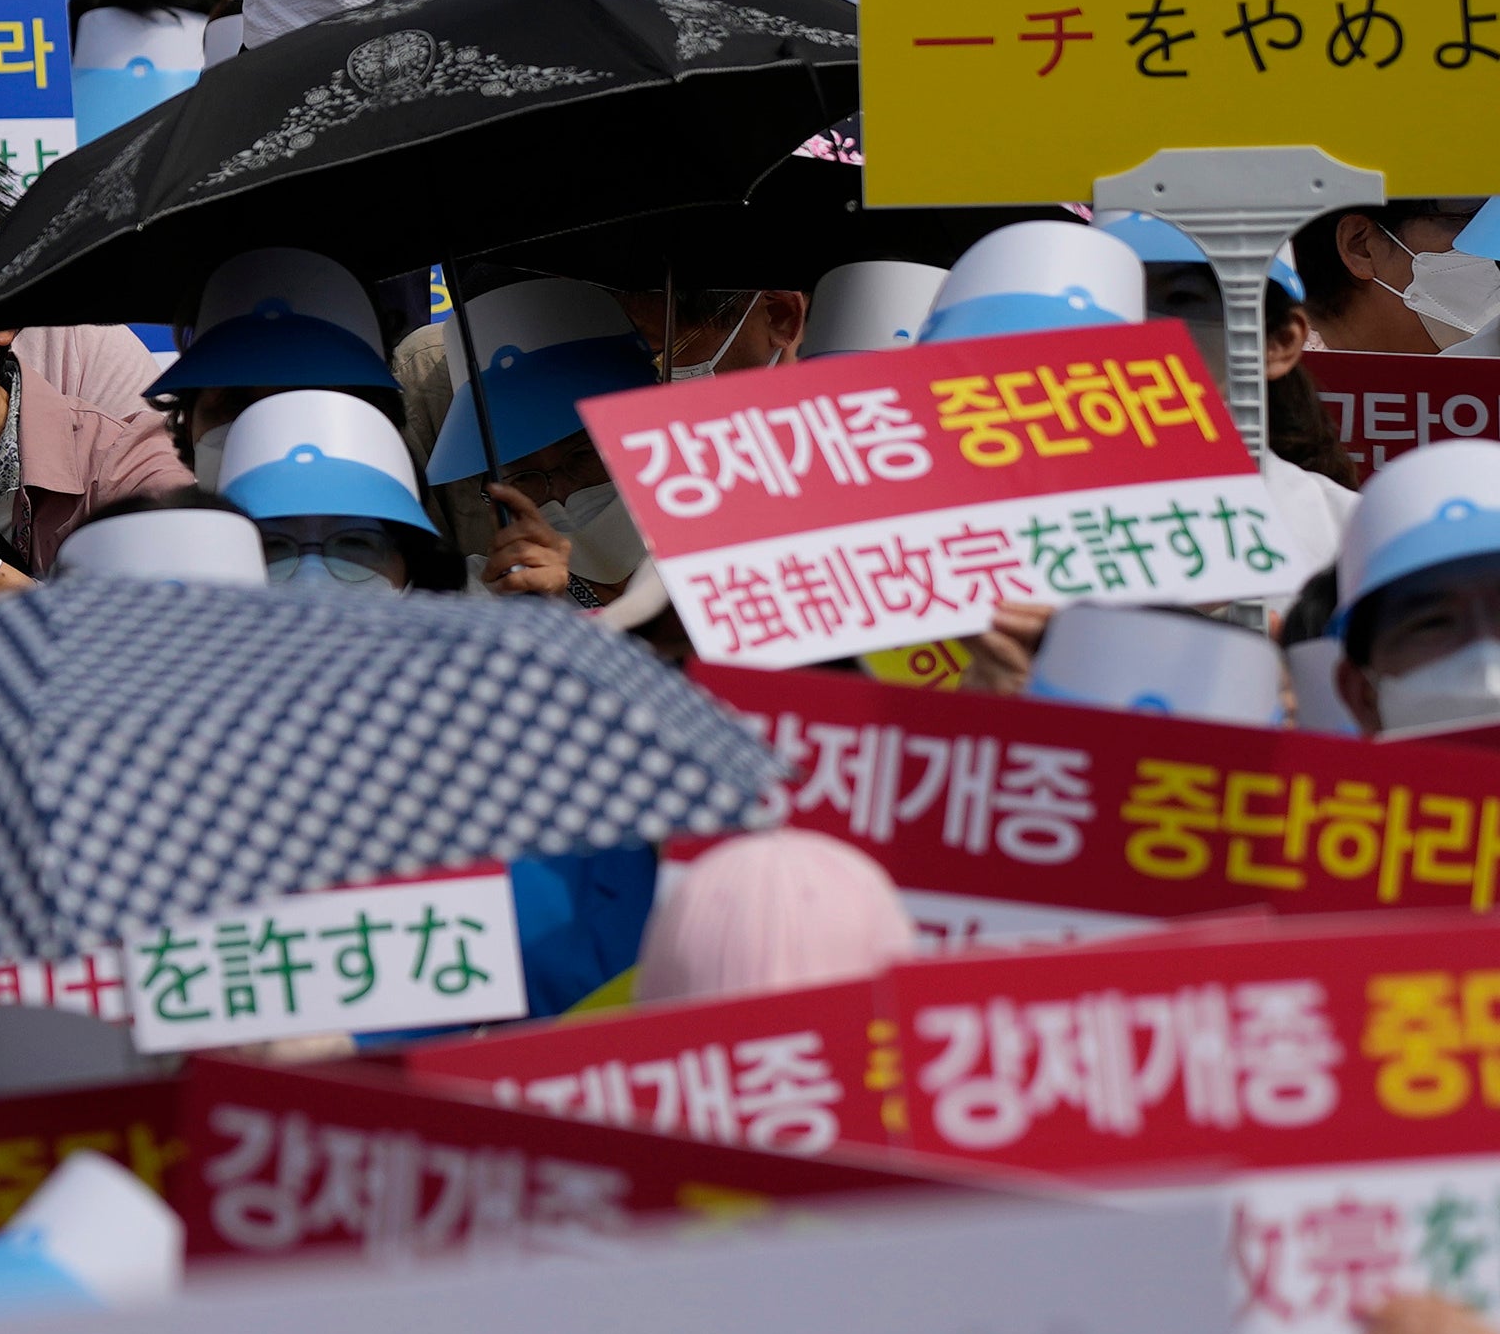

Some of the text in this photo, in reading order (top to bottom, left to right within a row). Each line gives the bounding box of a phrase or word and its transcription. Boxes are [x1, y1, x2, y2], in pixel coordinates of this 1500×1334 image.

[620, 352, 1221, 519] 강제개종 중단하라
[689, 494, 1287, 657] 強制改宗を許すな
[1121, 756, 1500, 915] 중단하라
[136, 904, 491, 1023] を許すな
[495, 1029, 844, 1160] 제개종
[913, 978, 1344, 1151] 강제개종
